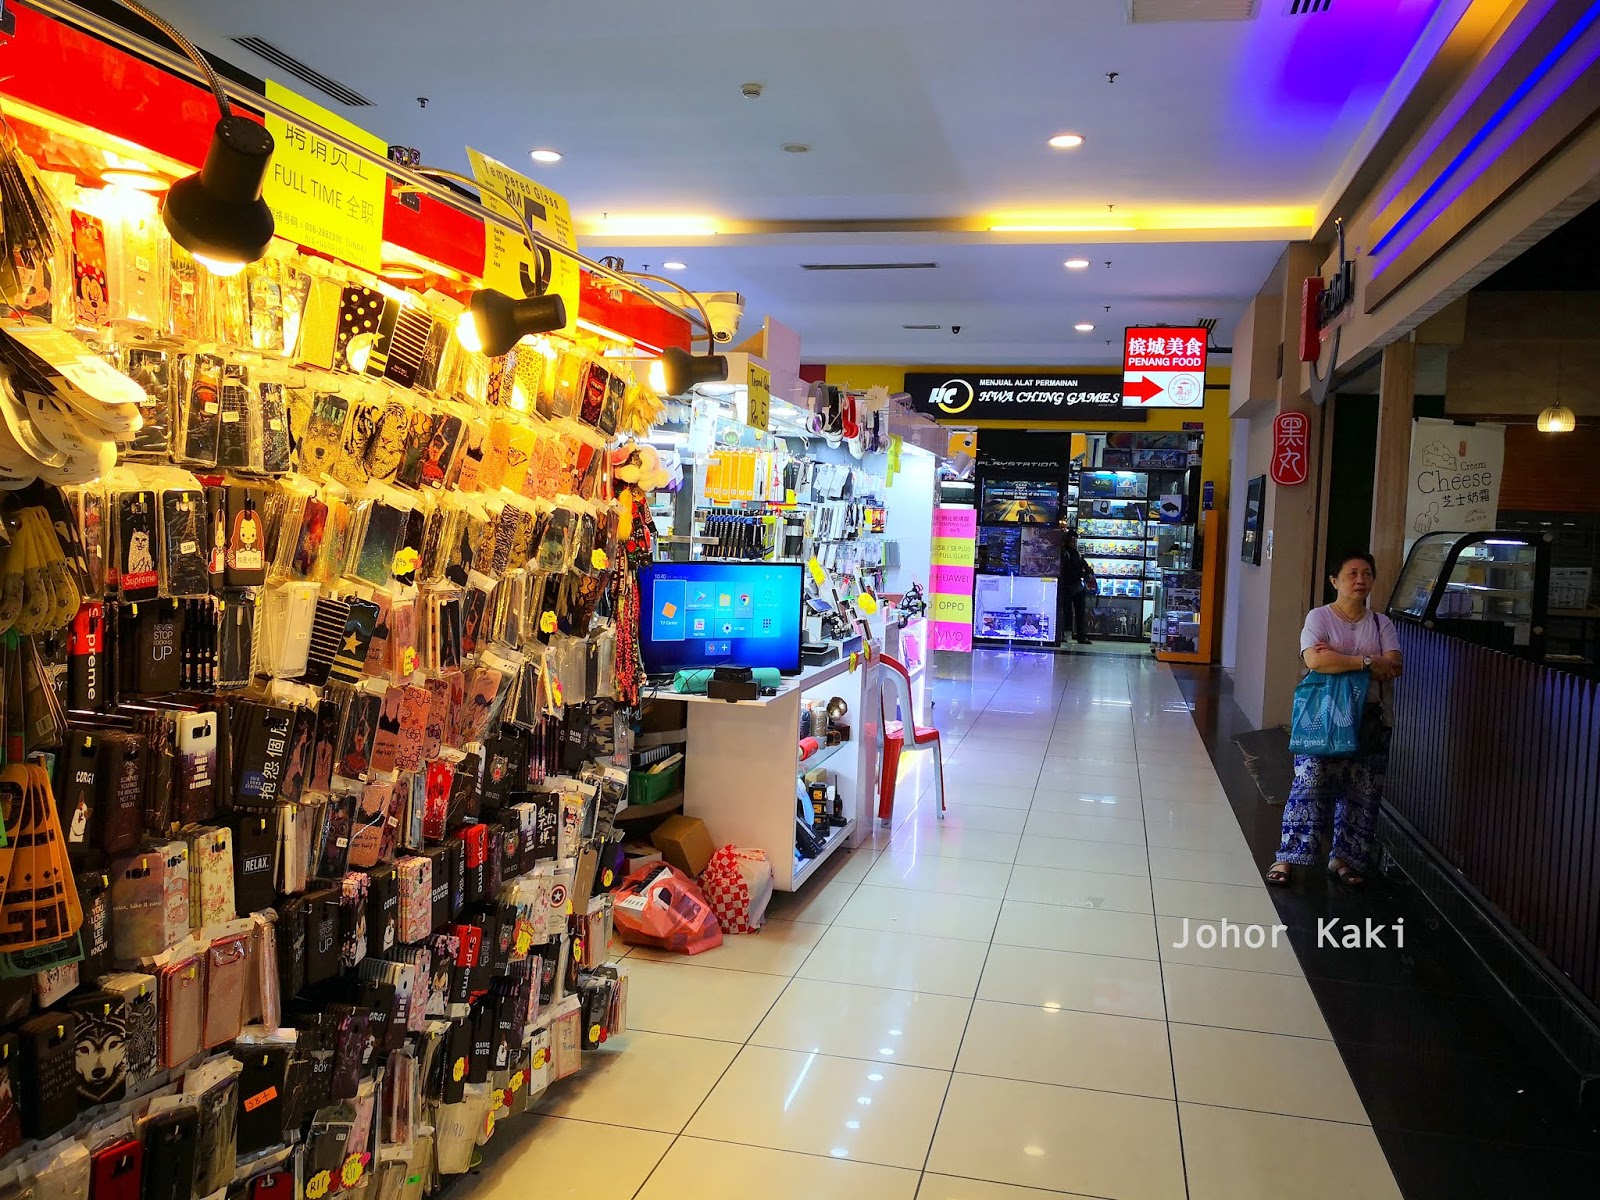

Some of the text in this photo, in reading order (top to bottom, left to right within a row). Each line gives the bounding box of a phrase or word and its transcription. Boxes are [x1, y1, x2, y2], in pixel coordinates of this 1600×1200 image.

[482, 159, 560, 210] Tempered Glass
[274, 163, 374, 226] FULL TIME 全职
[505, 186, 552, 299] RM 5
[1128, 337, 1203, 356] 槟城美食
[1128, 357, 1202, 367] PENANG FOOD
[979, 379, 1078, 387] MENJUAL ALAT PERMAINAN
[928, 387, 957, 404] HC
[978, 390, 1121, 406] HWA CHING GAMES
[1279, 417, 1304, 478] 黑丸
[1460, 461, 1487, 471] Cream
[1417, 470, 1492, 494] Cheese
[1442, 488, 1490, 508] 芝士奶霜
[125, 573, 157, 586] Supreme
[936, 573, 969, 583] HUAWEI
[938, 600, 965, 612] OPPO
[153, 623, 174, 631] NEVER
[153, 630, 174, 640] STOP
[938, 629, 964, 642] VIVO
[86, 607, 97, 700] Spreme
[153, 645, 173, 661] UP
[76, 770, 95, 785] CORGI
[245, 856, 270, 872] RELAX.
[432, 881, 449, 896] GAME
[432, 889, 449, 903] OVER
[91, 903, 104, 916] YOU
[90, 910, 106, 925] LOVE
[93, 926, 105, 939] LET
[90, 940, 108, 957] KNOW
[318, 937, 333, 953] UP
[368, 1011, 386, 1022] ORGI
[475, 1041, 491, 1049] GAME
[313, 1063, 328, 1073] BOY
